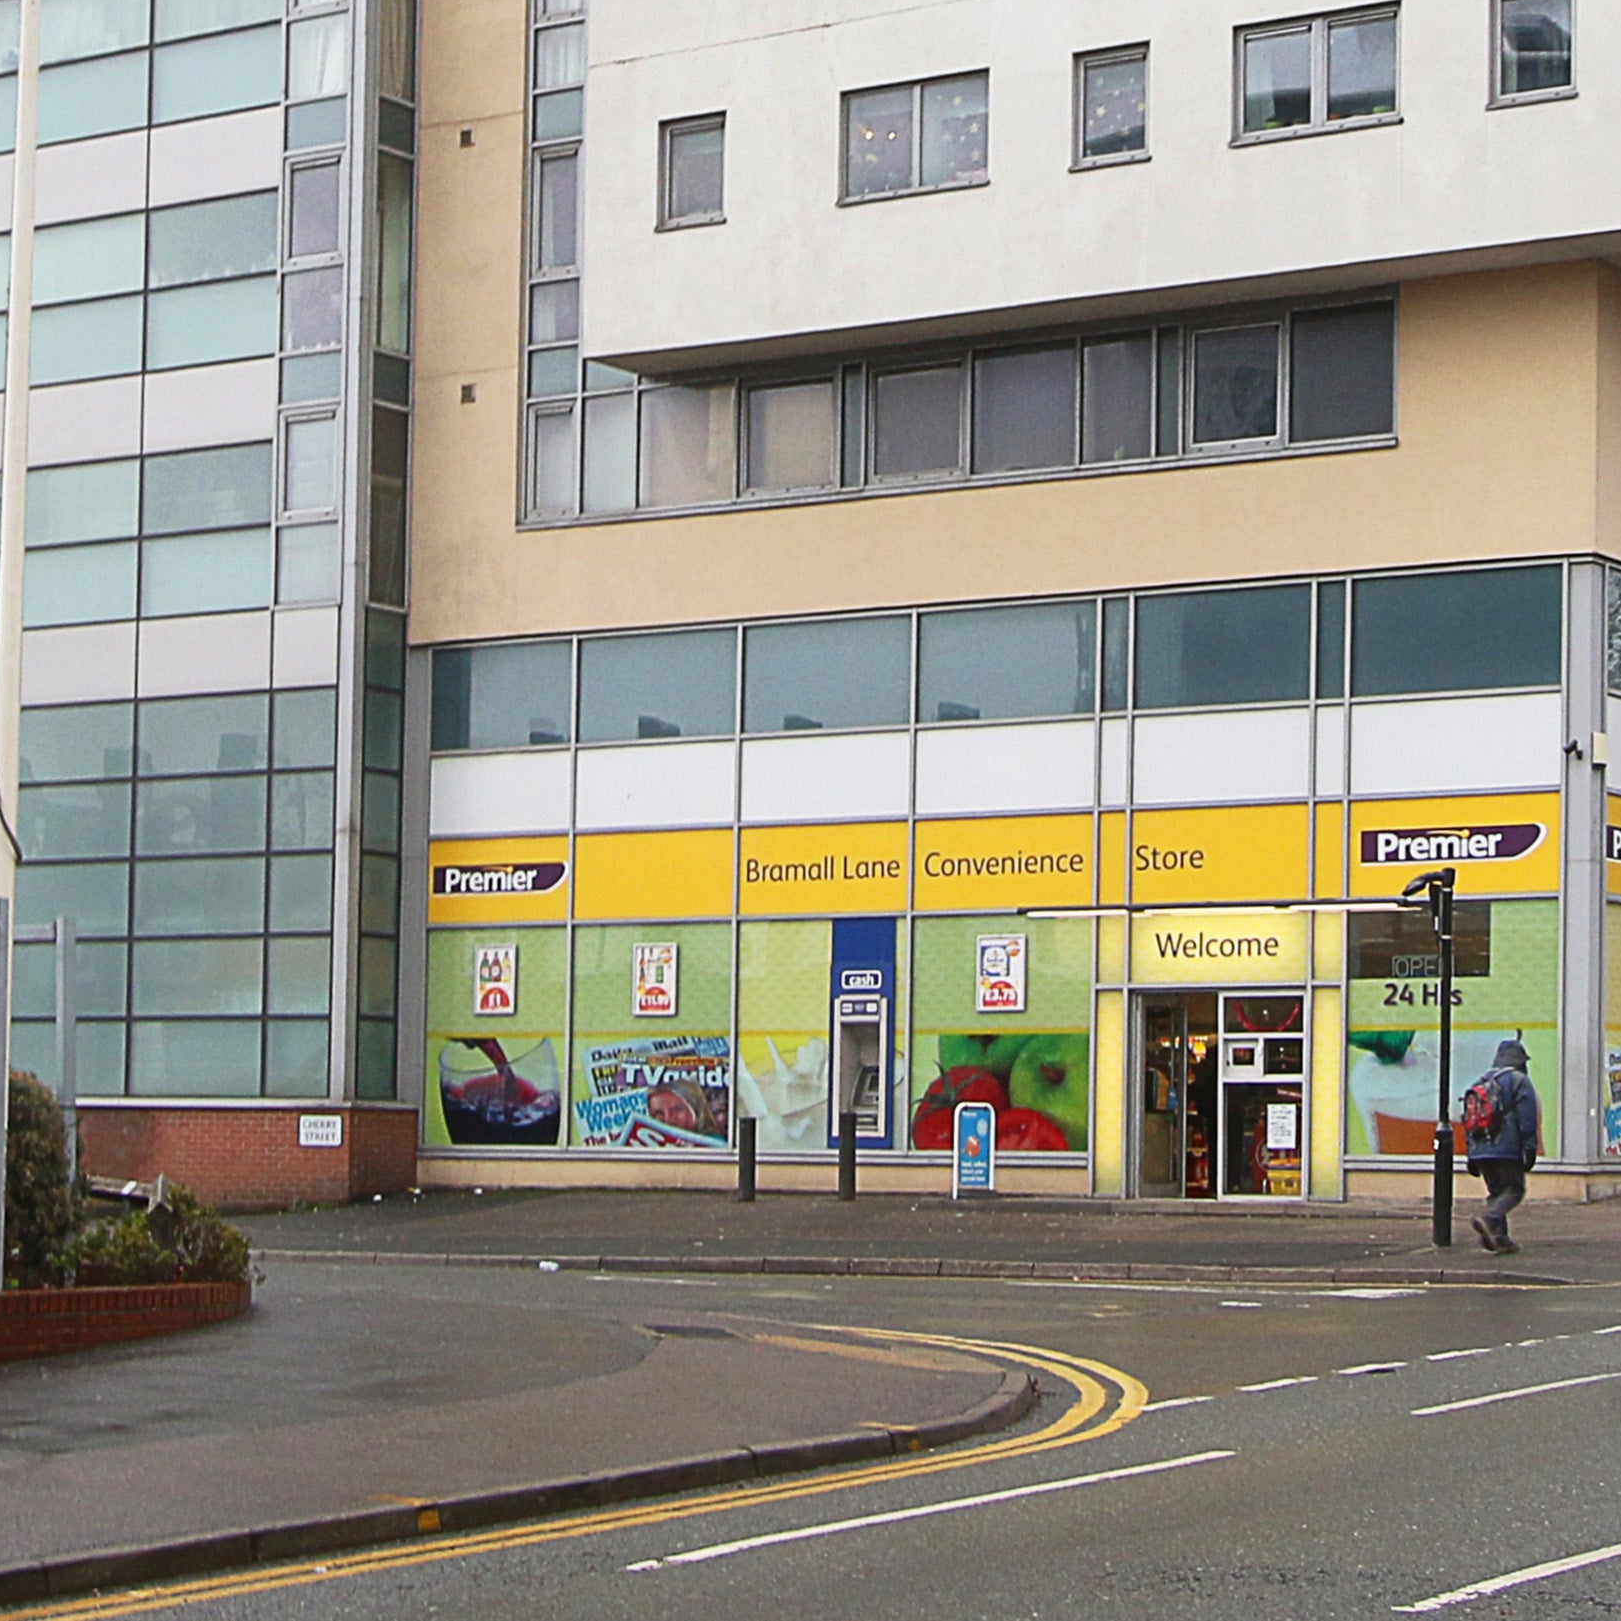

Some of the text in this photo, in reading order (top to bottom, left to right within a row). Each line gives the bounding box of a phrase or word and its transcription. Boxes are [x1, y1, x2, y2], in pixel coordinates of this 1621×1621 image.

[1376, 832, 1502, 862] Premier
[746, 845, 1205, 882] Bramall Lane Convenience Store
[445, 866, 538, 893] Premier
[1155, 933, 1280, 960] Welcome
[1395, 957, 1443, 977] OPE
[1383, 983, 1463, 1006] 24 Hs
